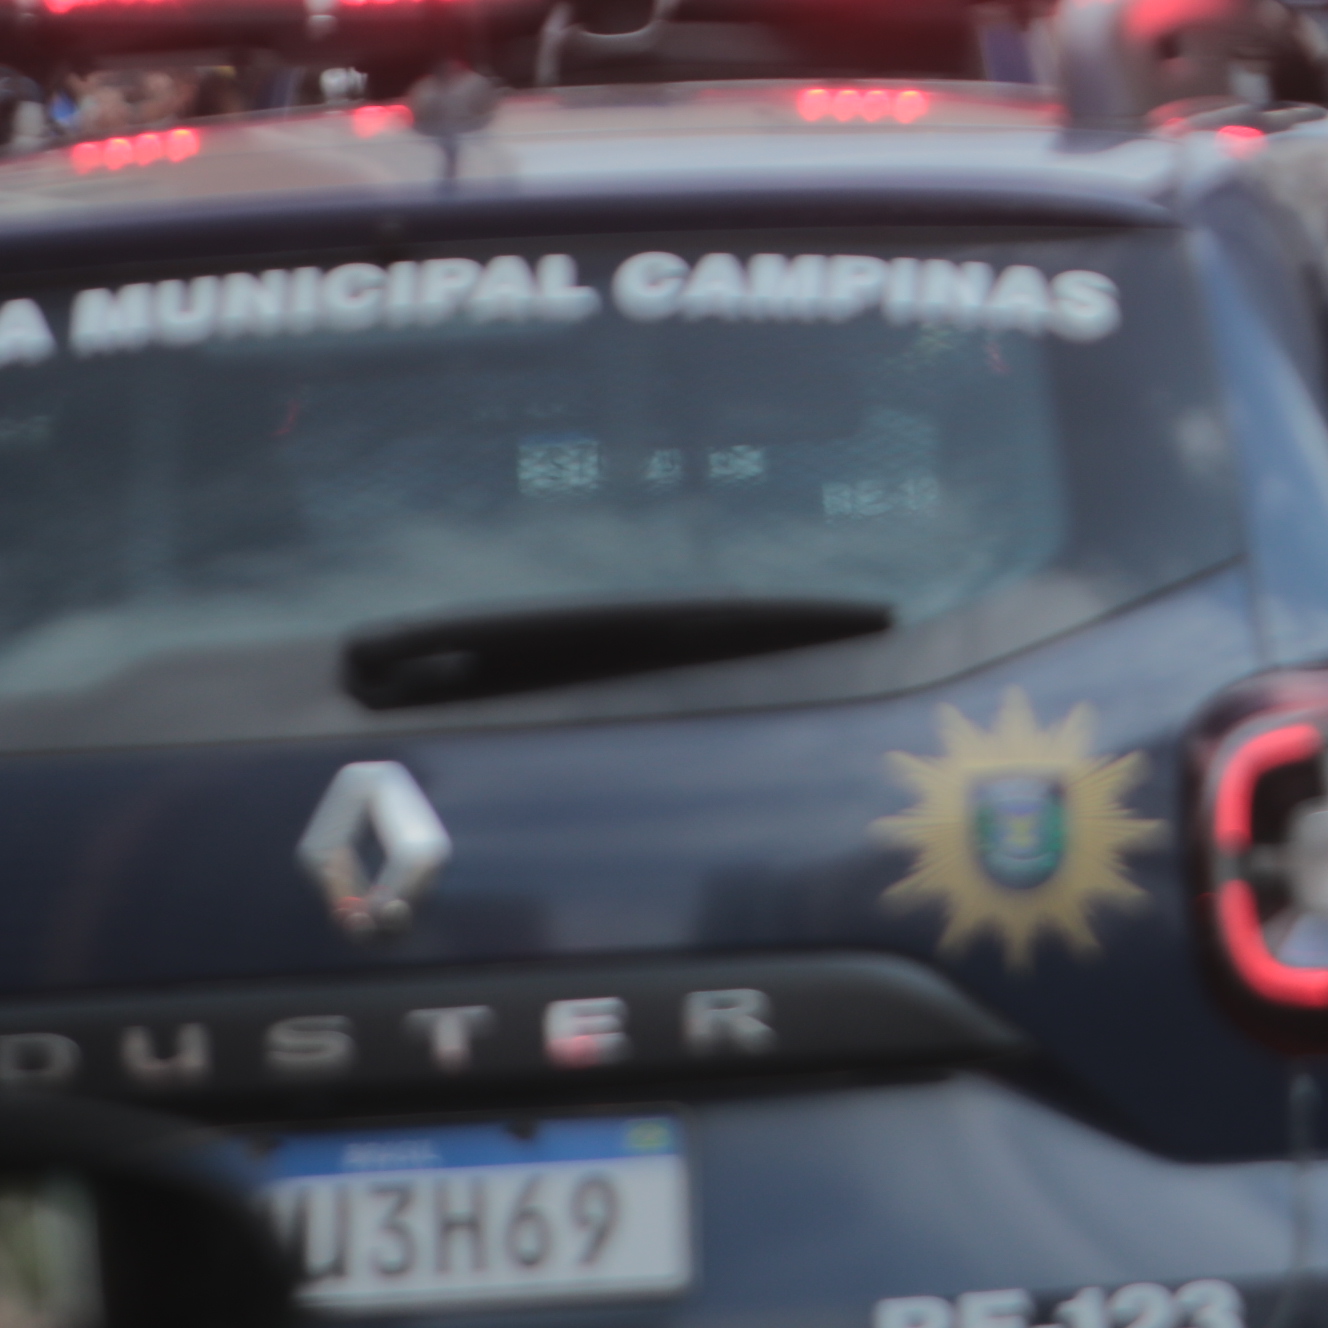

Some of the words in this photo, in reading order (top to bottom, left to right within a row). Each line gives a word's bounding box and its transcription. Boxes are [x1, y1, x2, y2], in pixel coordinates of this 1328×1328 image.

[69, 252, 602, 356] MUNICIPAL
[612, 250, 1124, 342] CAMPINAS
[0, 987, 779, 1085] DUSTER
